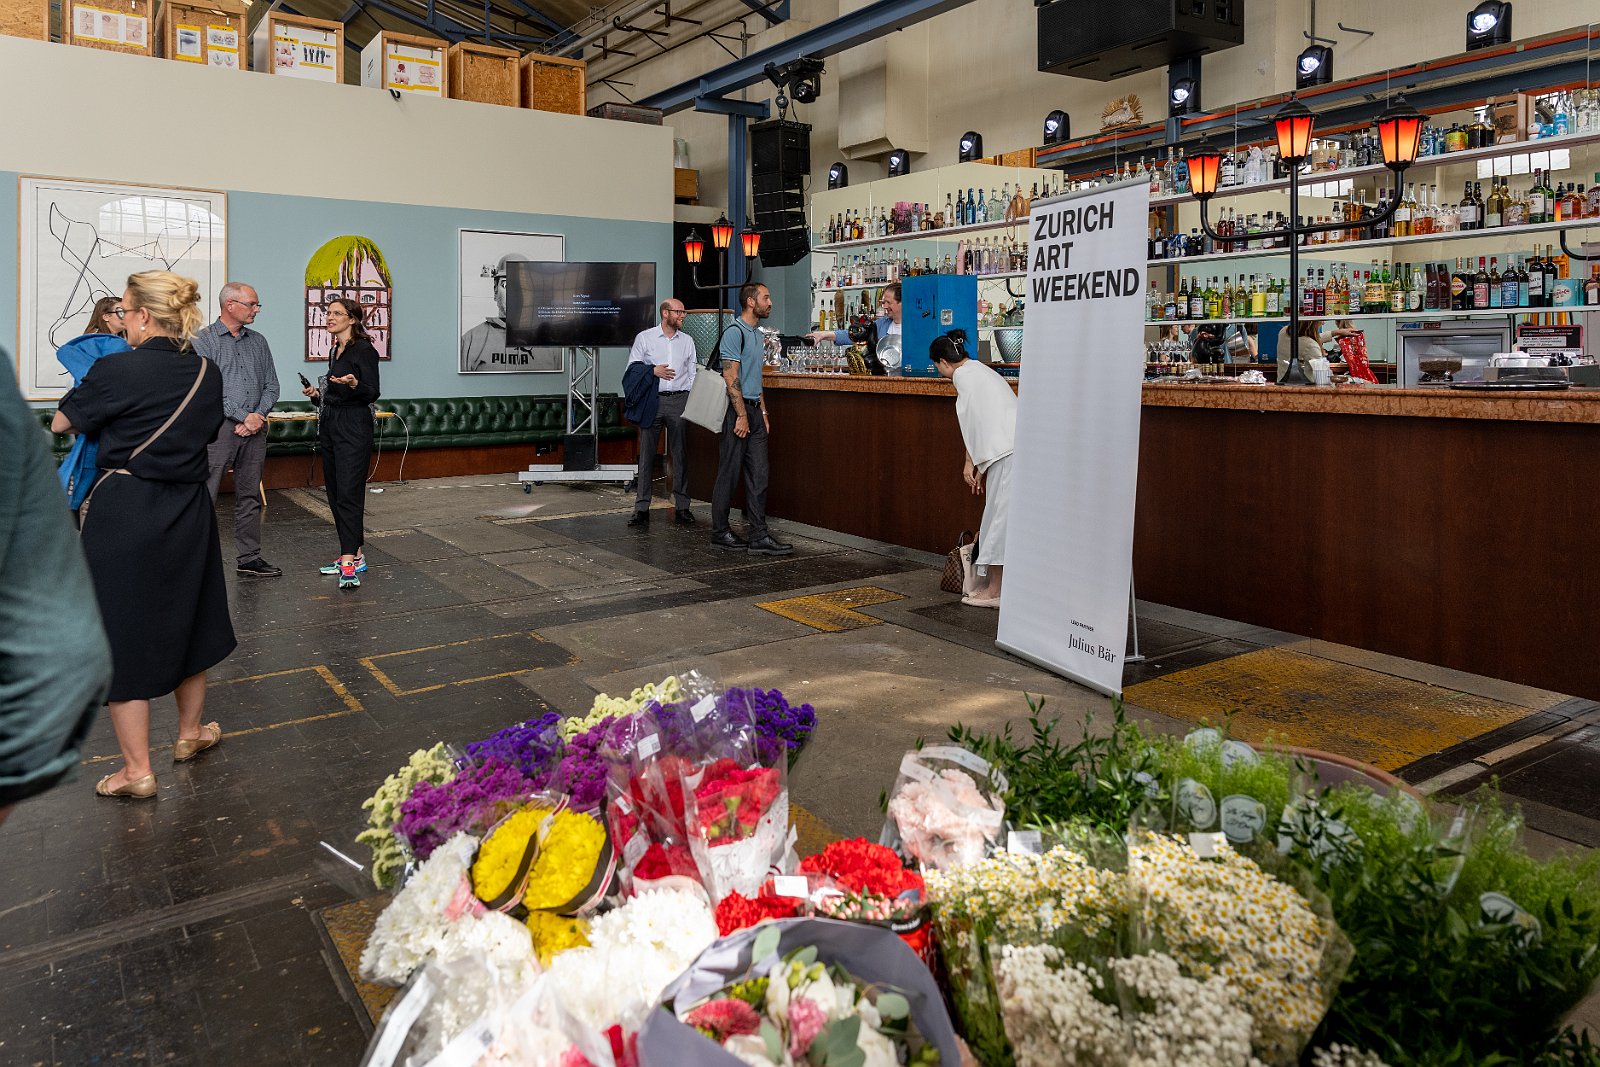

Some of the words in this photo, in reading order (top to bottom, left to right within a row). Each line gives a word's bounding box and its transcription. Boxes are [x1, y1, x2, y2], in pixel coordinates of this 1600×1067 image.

[1034, 201, 1115, 242] ZURICH
[1033, 241, 1074, 272] ART
[1032, 267, 1140, 303] WEEKEND
[491, 352, 529, 365] PUMA
[1068, 633, 1095, 656] Julius
[1098, 644, 1117, 663] Bär
